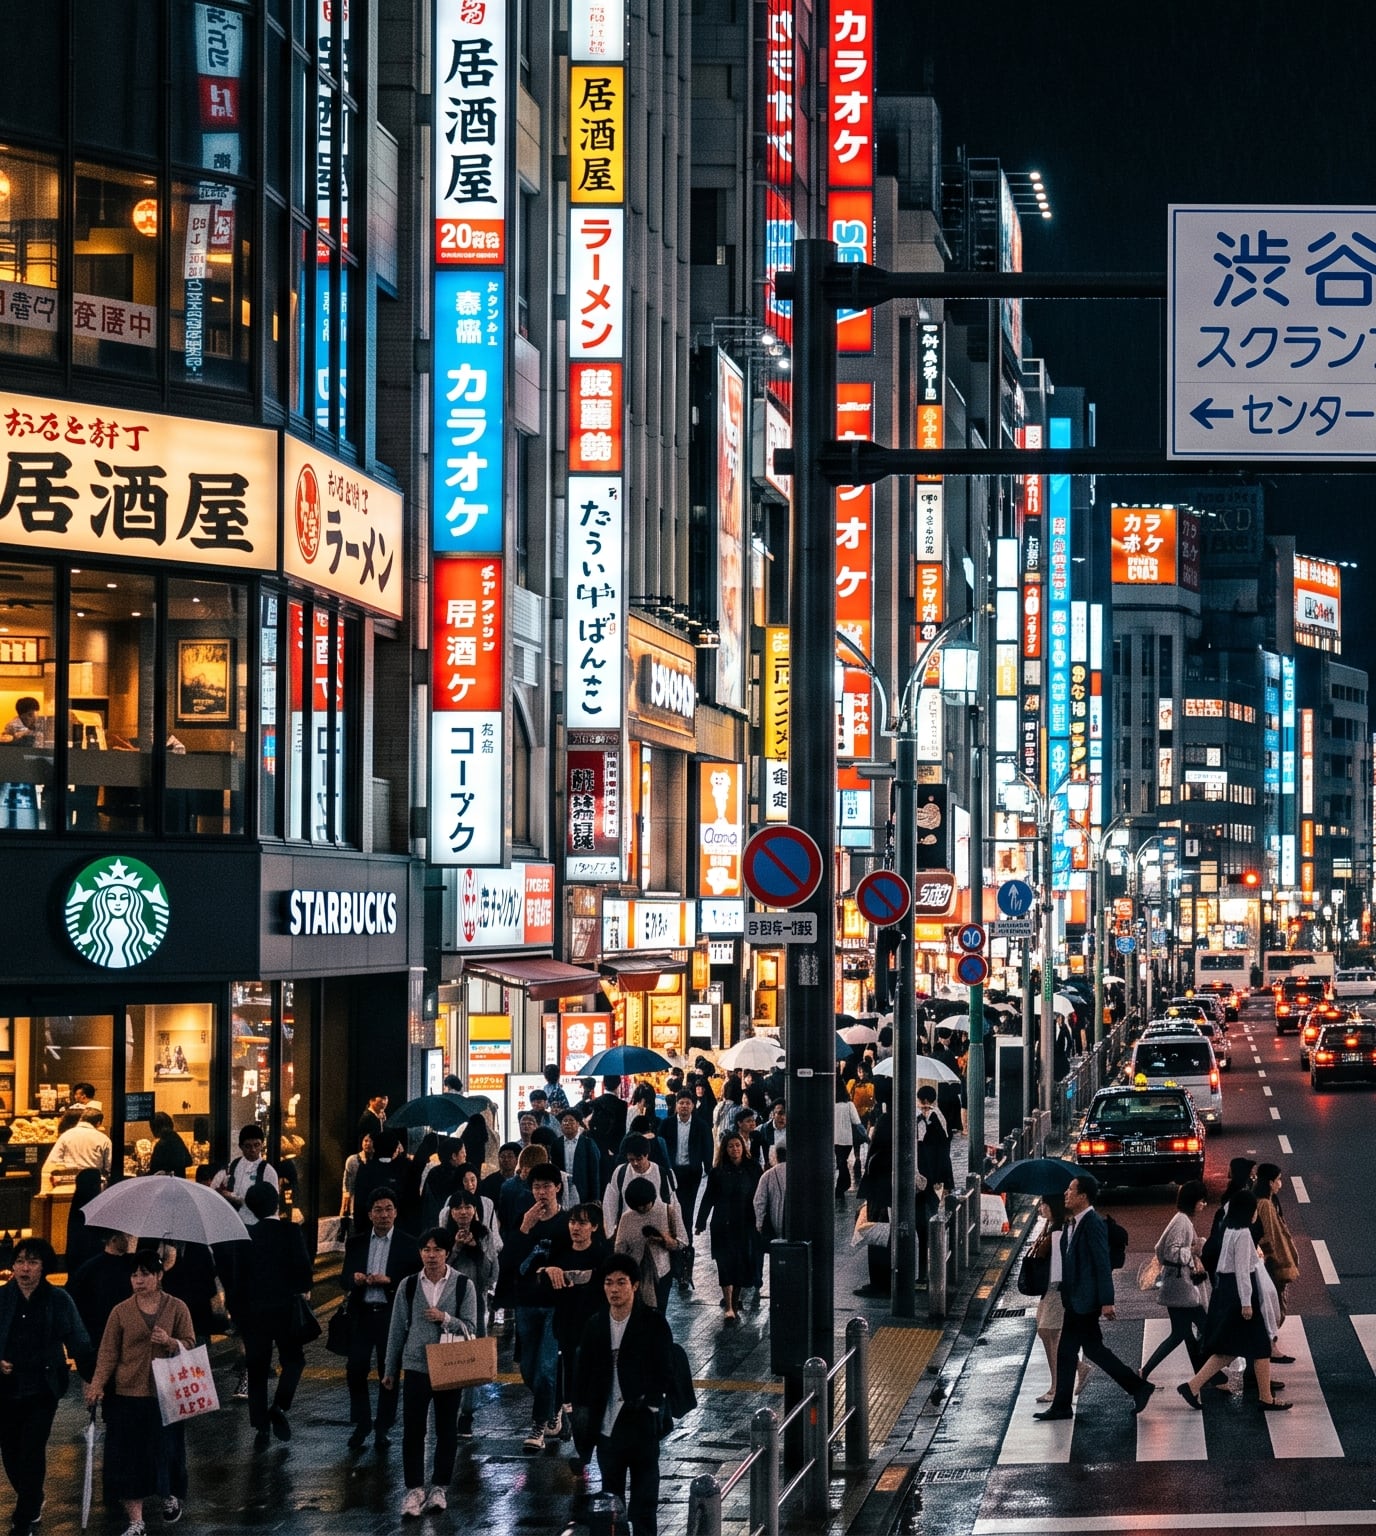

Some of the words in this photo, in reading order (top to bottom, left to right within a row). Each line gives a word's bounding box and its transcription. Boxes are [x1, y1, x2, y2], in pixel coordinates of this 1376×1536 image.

[444, 38, 498, 204] 居酒屋
[578, 77, 616, 192] 居酒屋
[833, 10, 868, 164] カラオケ
[580, 219, 613, 349] ラーメン
[0, 452, 254, 552] 居酒屋
[445, 363, 489, 537] カラオケ
[325, 509, 394, 593] ラーメン
[1124, 514, 1161, 533] カラ
[290, 889, 396, 935] STARBUCKS
